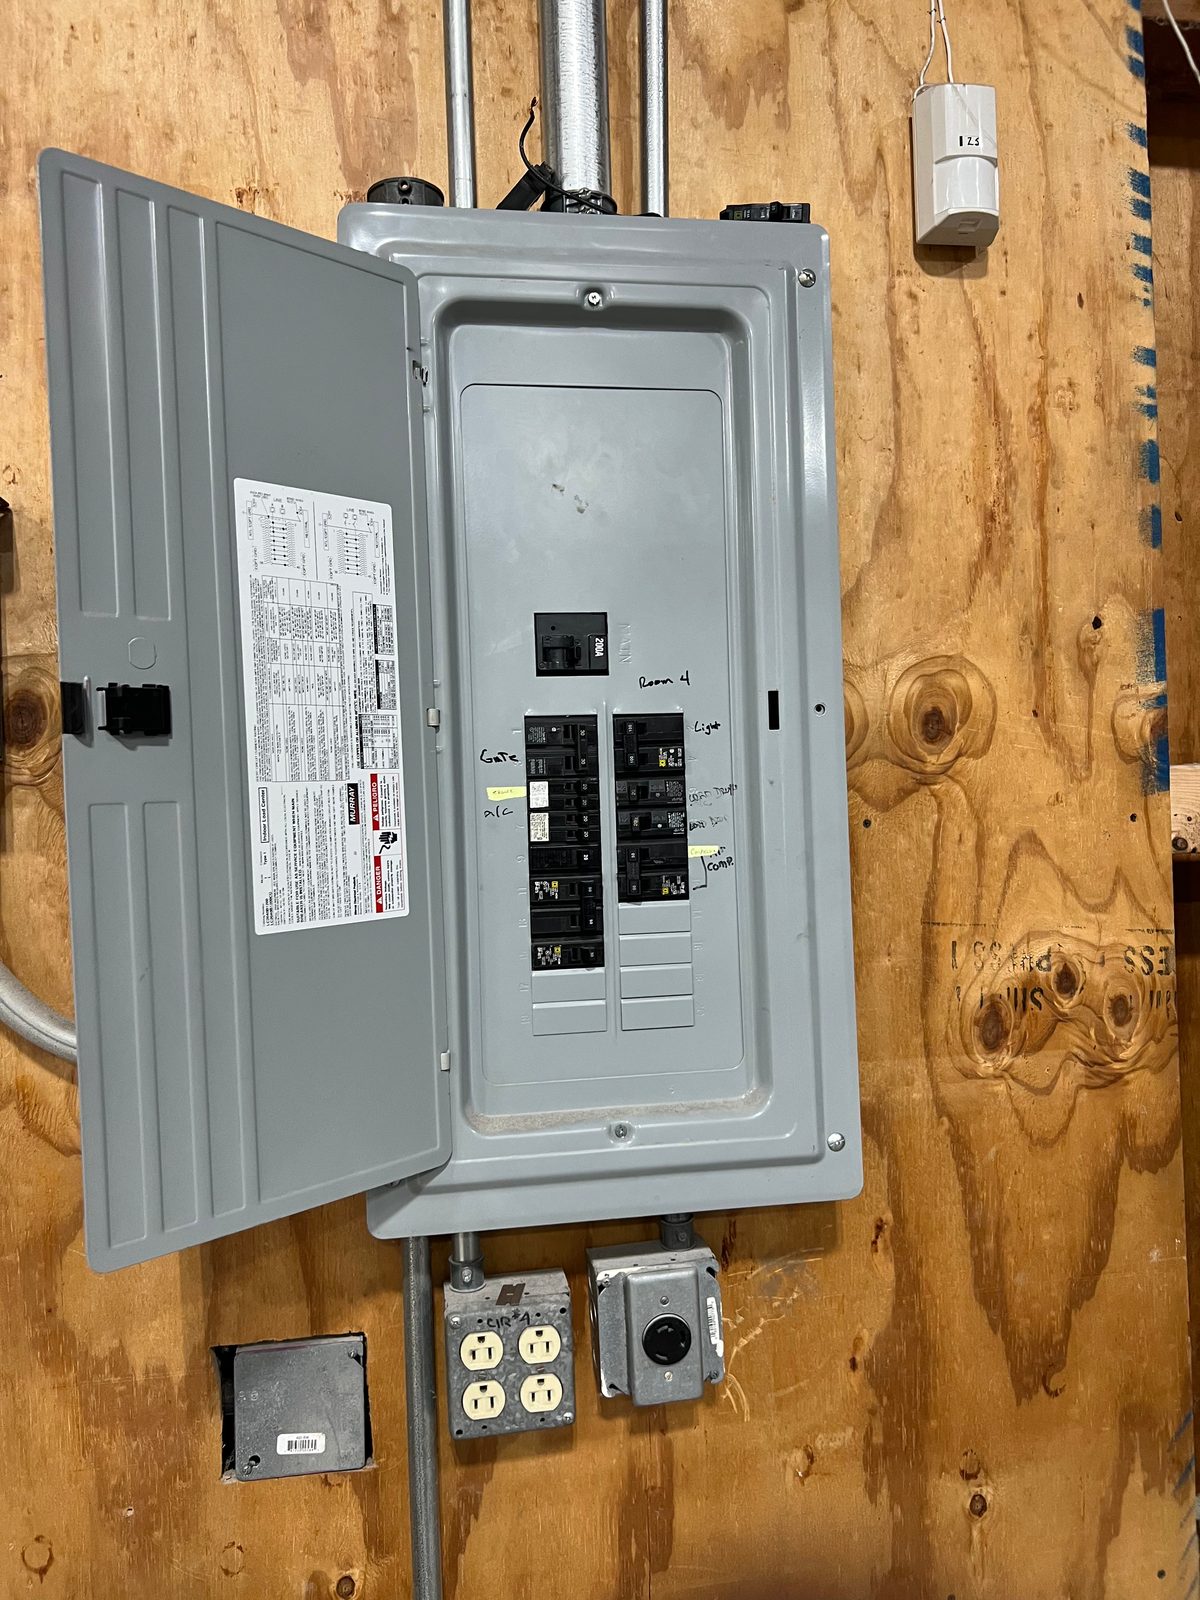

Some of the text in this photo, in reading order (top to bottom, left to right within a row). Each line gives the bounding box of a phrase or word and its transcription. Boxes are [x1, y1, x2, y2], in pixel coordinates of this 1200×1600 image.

[595, 637, 604, 657] 200A
[639, 670, 690, 689] Room 4
[348, 786, 357, 822] MURRAY
[487, 1316, 511, 1328] CIR
